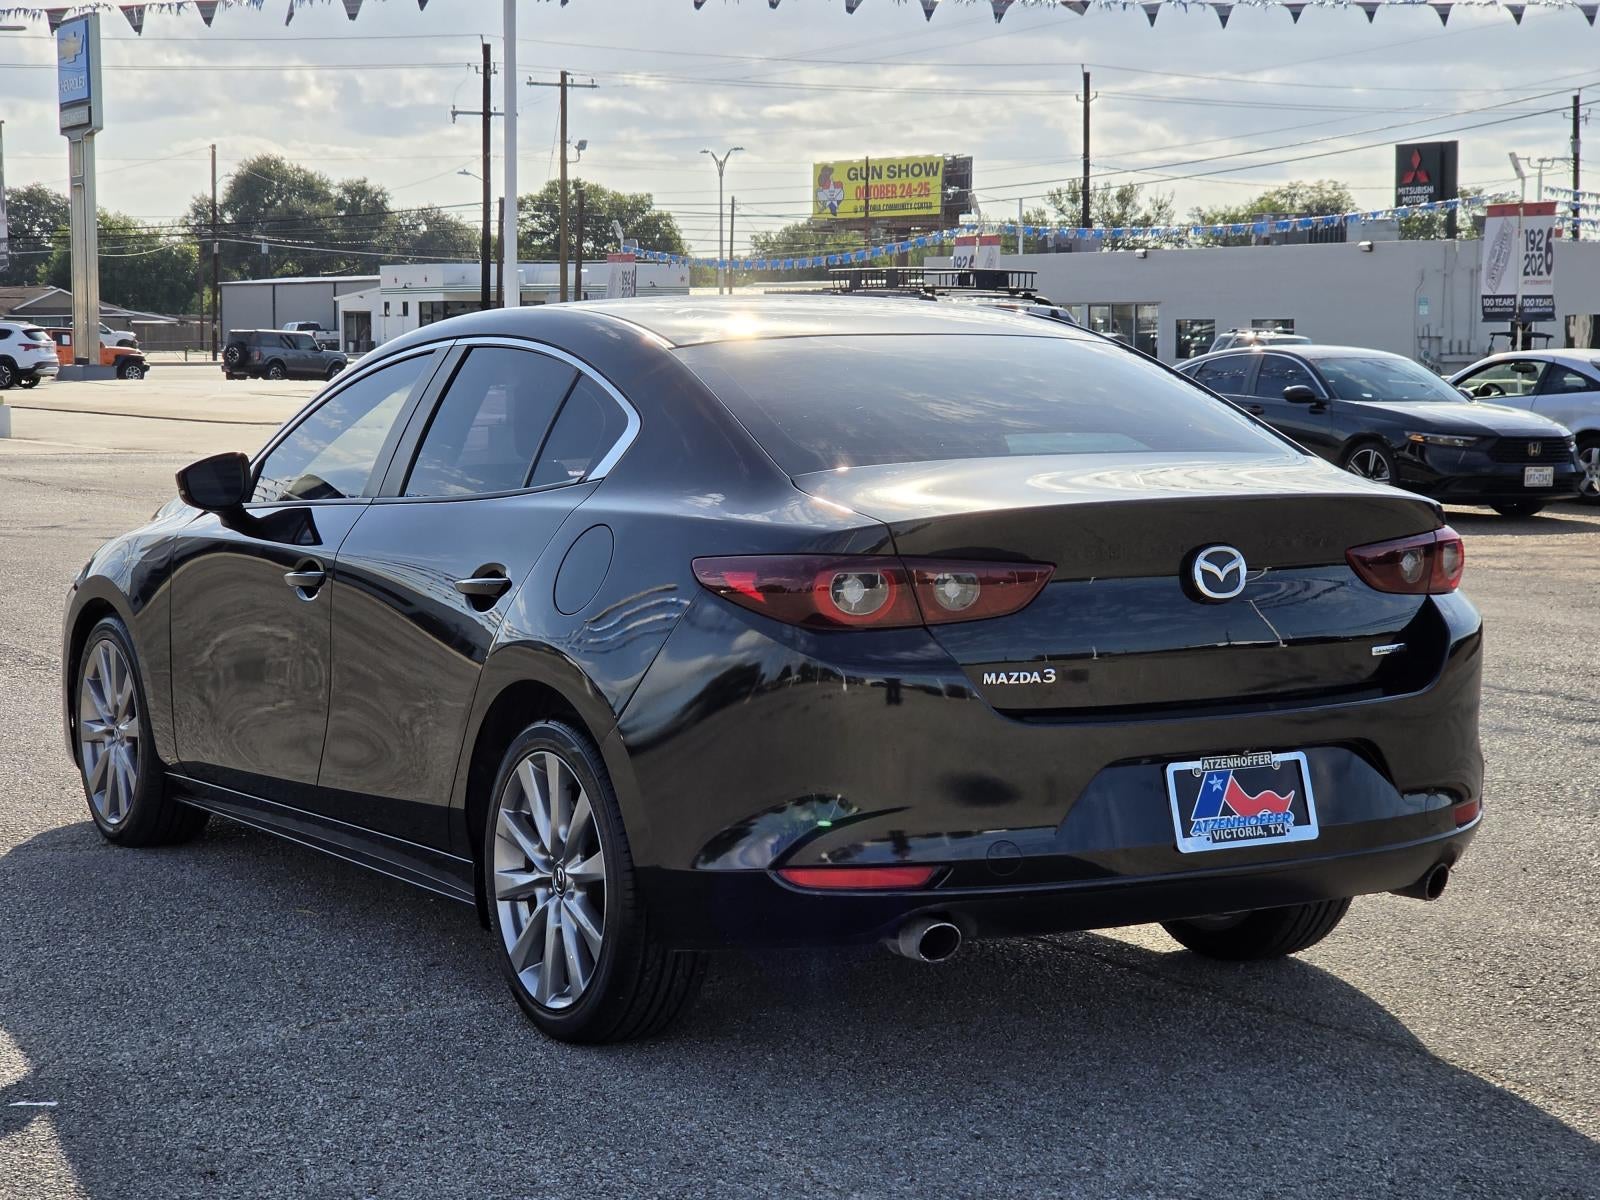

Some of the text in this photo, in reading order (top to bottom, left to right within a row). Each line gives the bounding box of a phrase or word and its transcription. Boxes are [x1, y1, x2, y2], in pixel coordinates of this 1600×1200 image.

[847, 161, 940, 181] GUN SHOW
[855, 184, 897, 200] OCTOBER
[1398, 185, 1434, 195] MITSUBISHI
[1402, 194, 1429, 204] MOTORS
[1483, 297, 1514, 306] 100 YEARS
[1523, 297, 1553, 306] 100 YEARS
[1202, 753, 1272, 770] ATZENHOFFER
[1193, 811, 1292, 833] ATZENHOFFER
[1212, 824, 1285, 841] VICTORIA, TX
